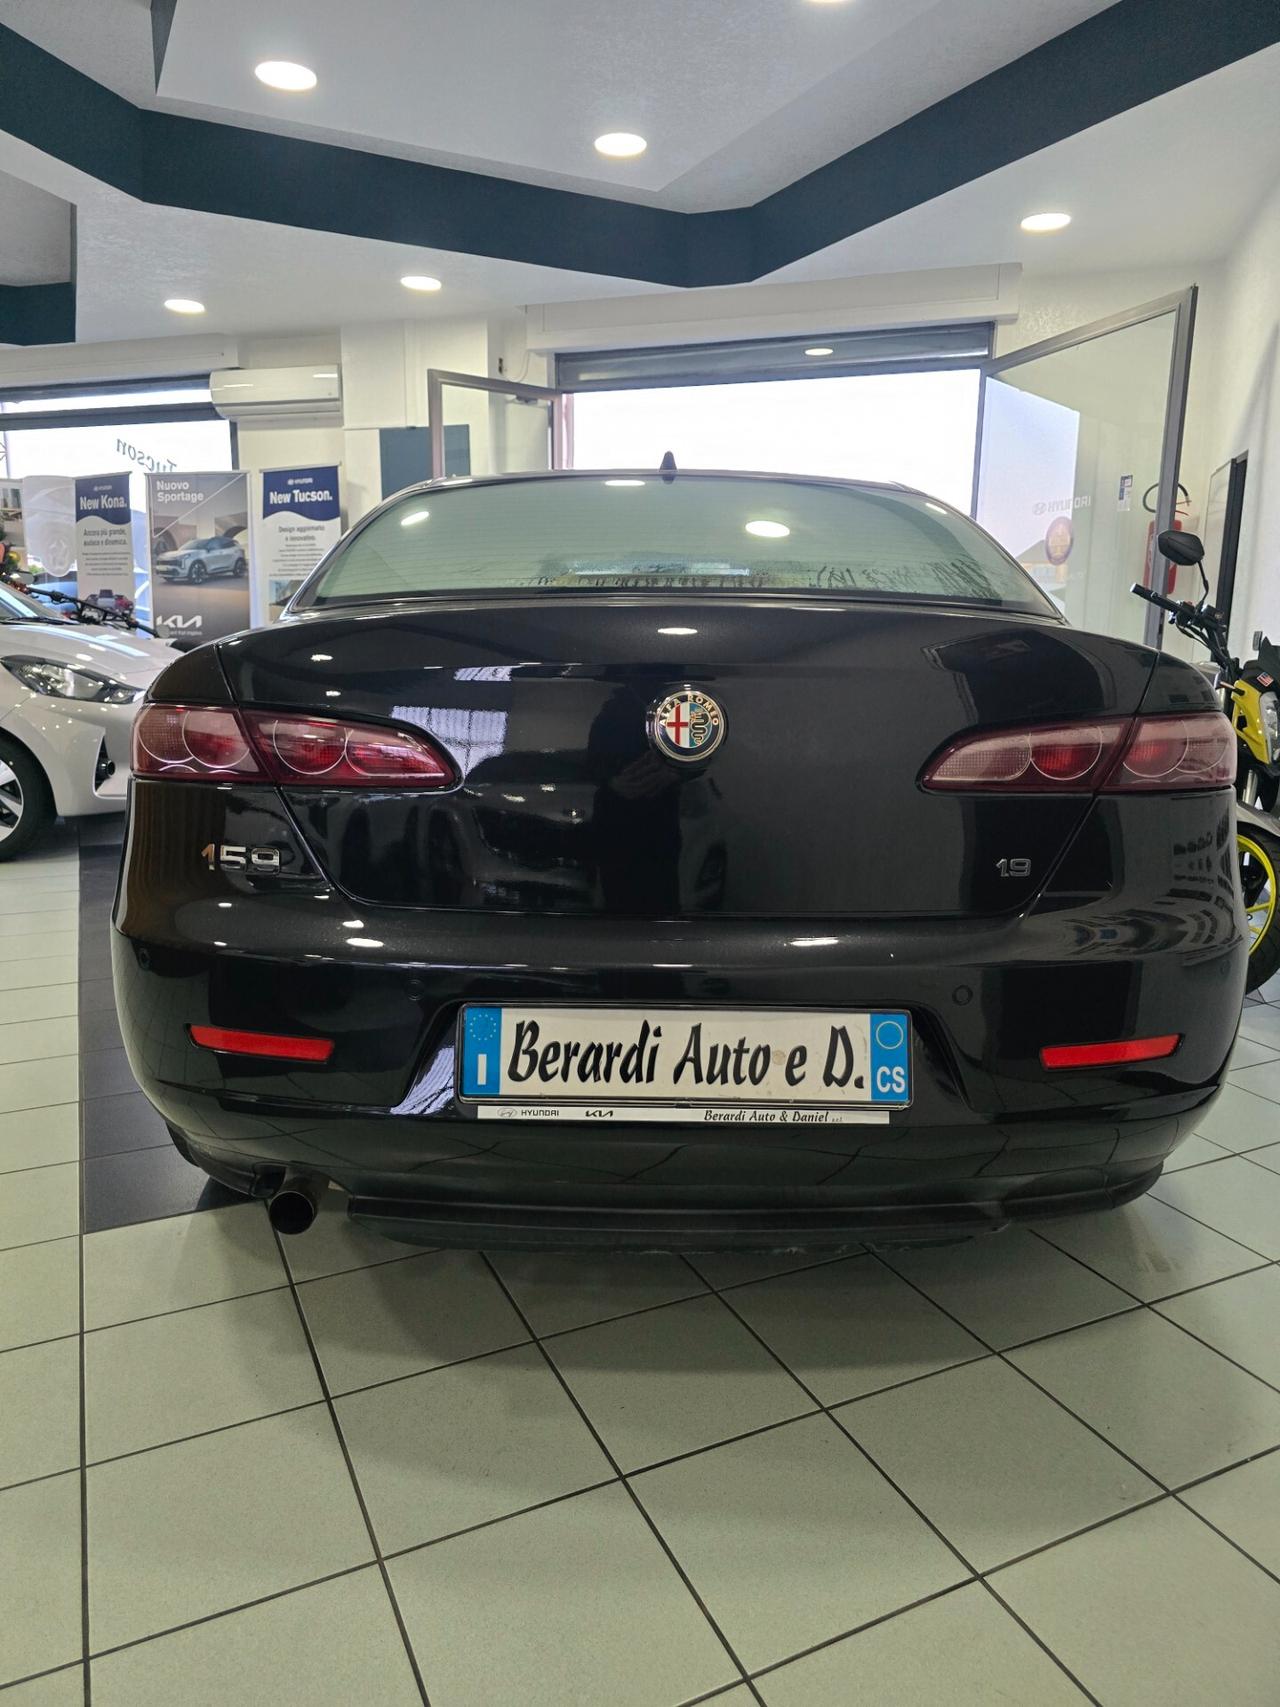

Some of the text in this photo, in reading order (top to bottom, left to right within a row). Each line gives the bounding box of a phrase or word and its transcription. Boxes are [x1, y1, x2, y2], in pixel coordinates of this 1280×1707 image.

[156, 480, 189, 491] Nuovo
[80, 494, 128, 510] New Kona.
[157, 491, 204, 504] Sportage
[269, 489, 333, 505] New Tucson.
[156, 615, 202, 628] KIA
[659, 694, 719, 727] ALFA ROMEO
[201, 843, 280, 874] 159
[507, 1019, 865, 1089] Berardi Auto e D.
[477, 1053, 487, 1086] I
[876, 1065, 905, 1094] CS
[585, 1110, 613, 1118] KIA
[704, 1109, 746, 1122] Berardi
[749, 1110, 775, 1122] Auto
[779, 1111, 788, 1122] &
[792, 1111, 829, 1123] Daniel
